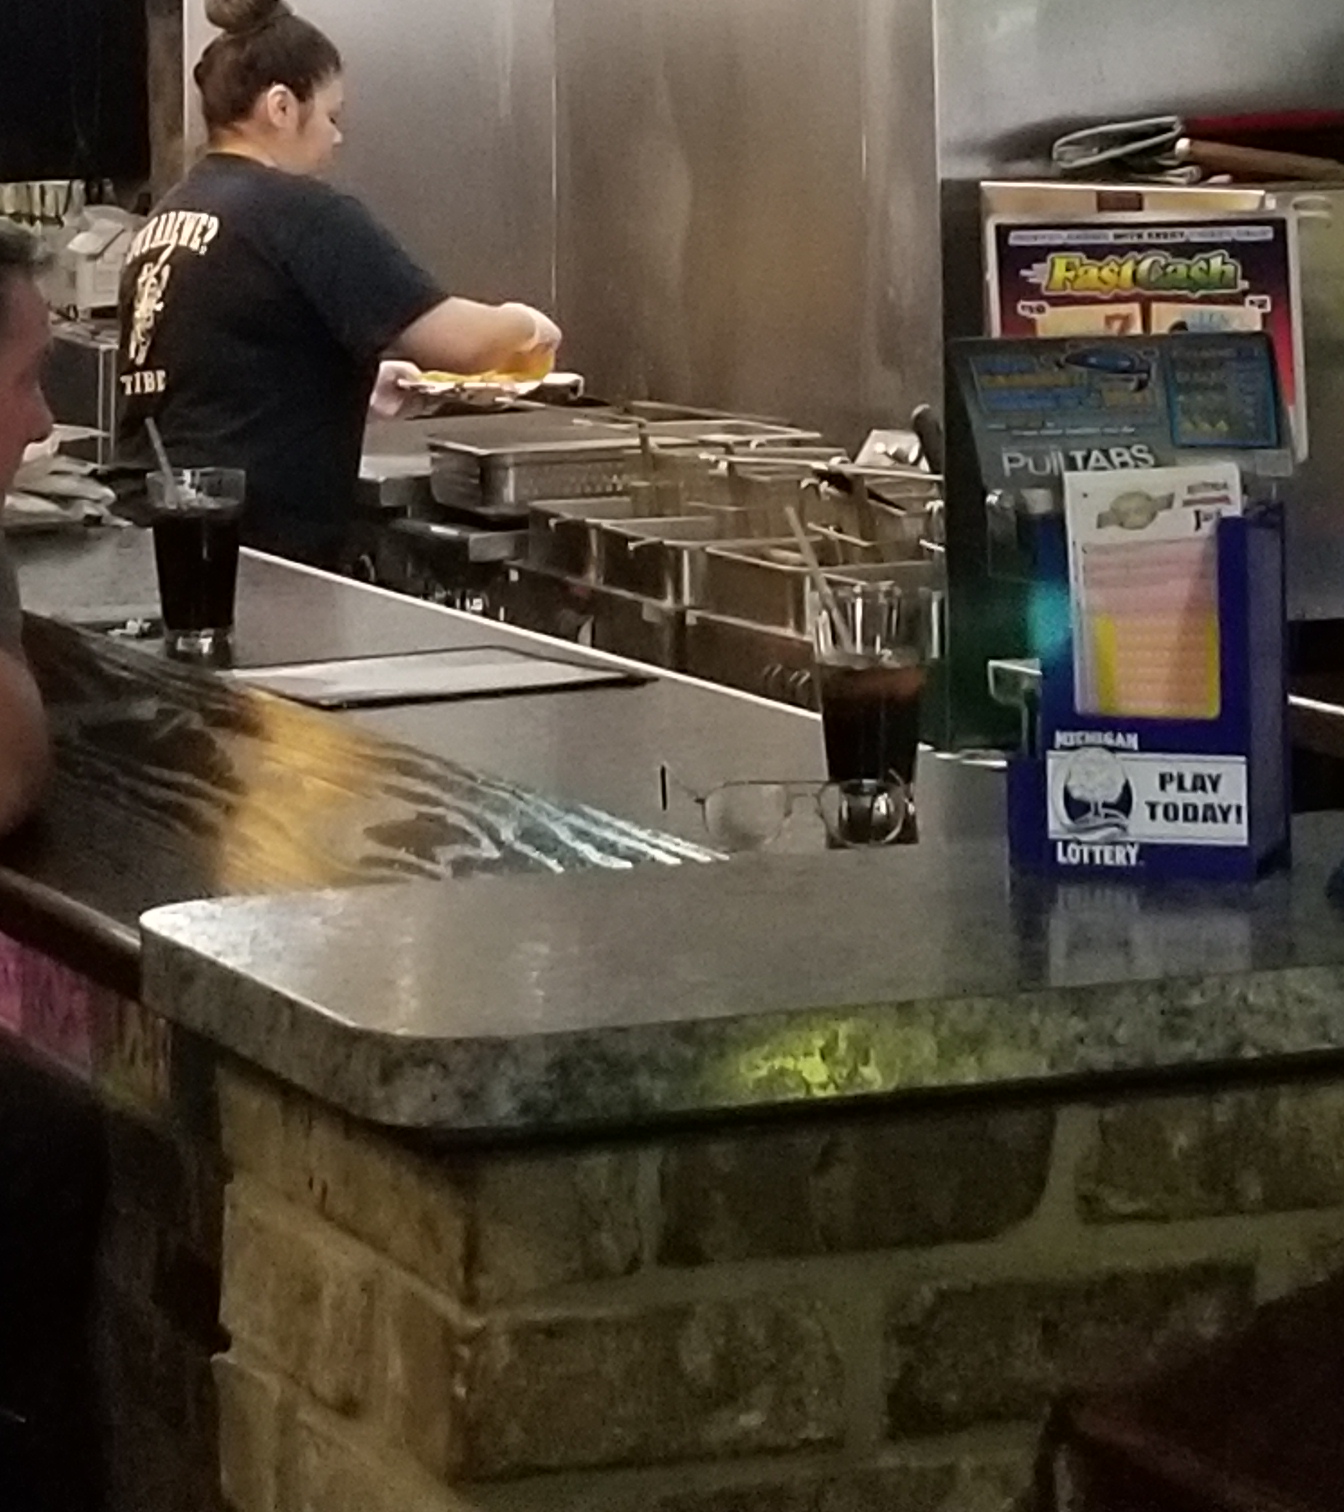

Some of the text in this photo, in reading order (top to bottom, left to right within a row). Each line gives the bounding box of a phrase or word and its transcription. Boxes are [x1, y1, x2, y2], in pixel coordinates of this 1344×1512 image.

[1055, 730, 1139, 751] MICHIGAN
[1158, 772, 1222, 794] PLAY
[1145, 801, 1242, 825] TODAY!
[1056, 841, 1139, 866] LOTTERY
